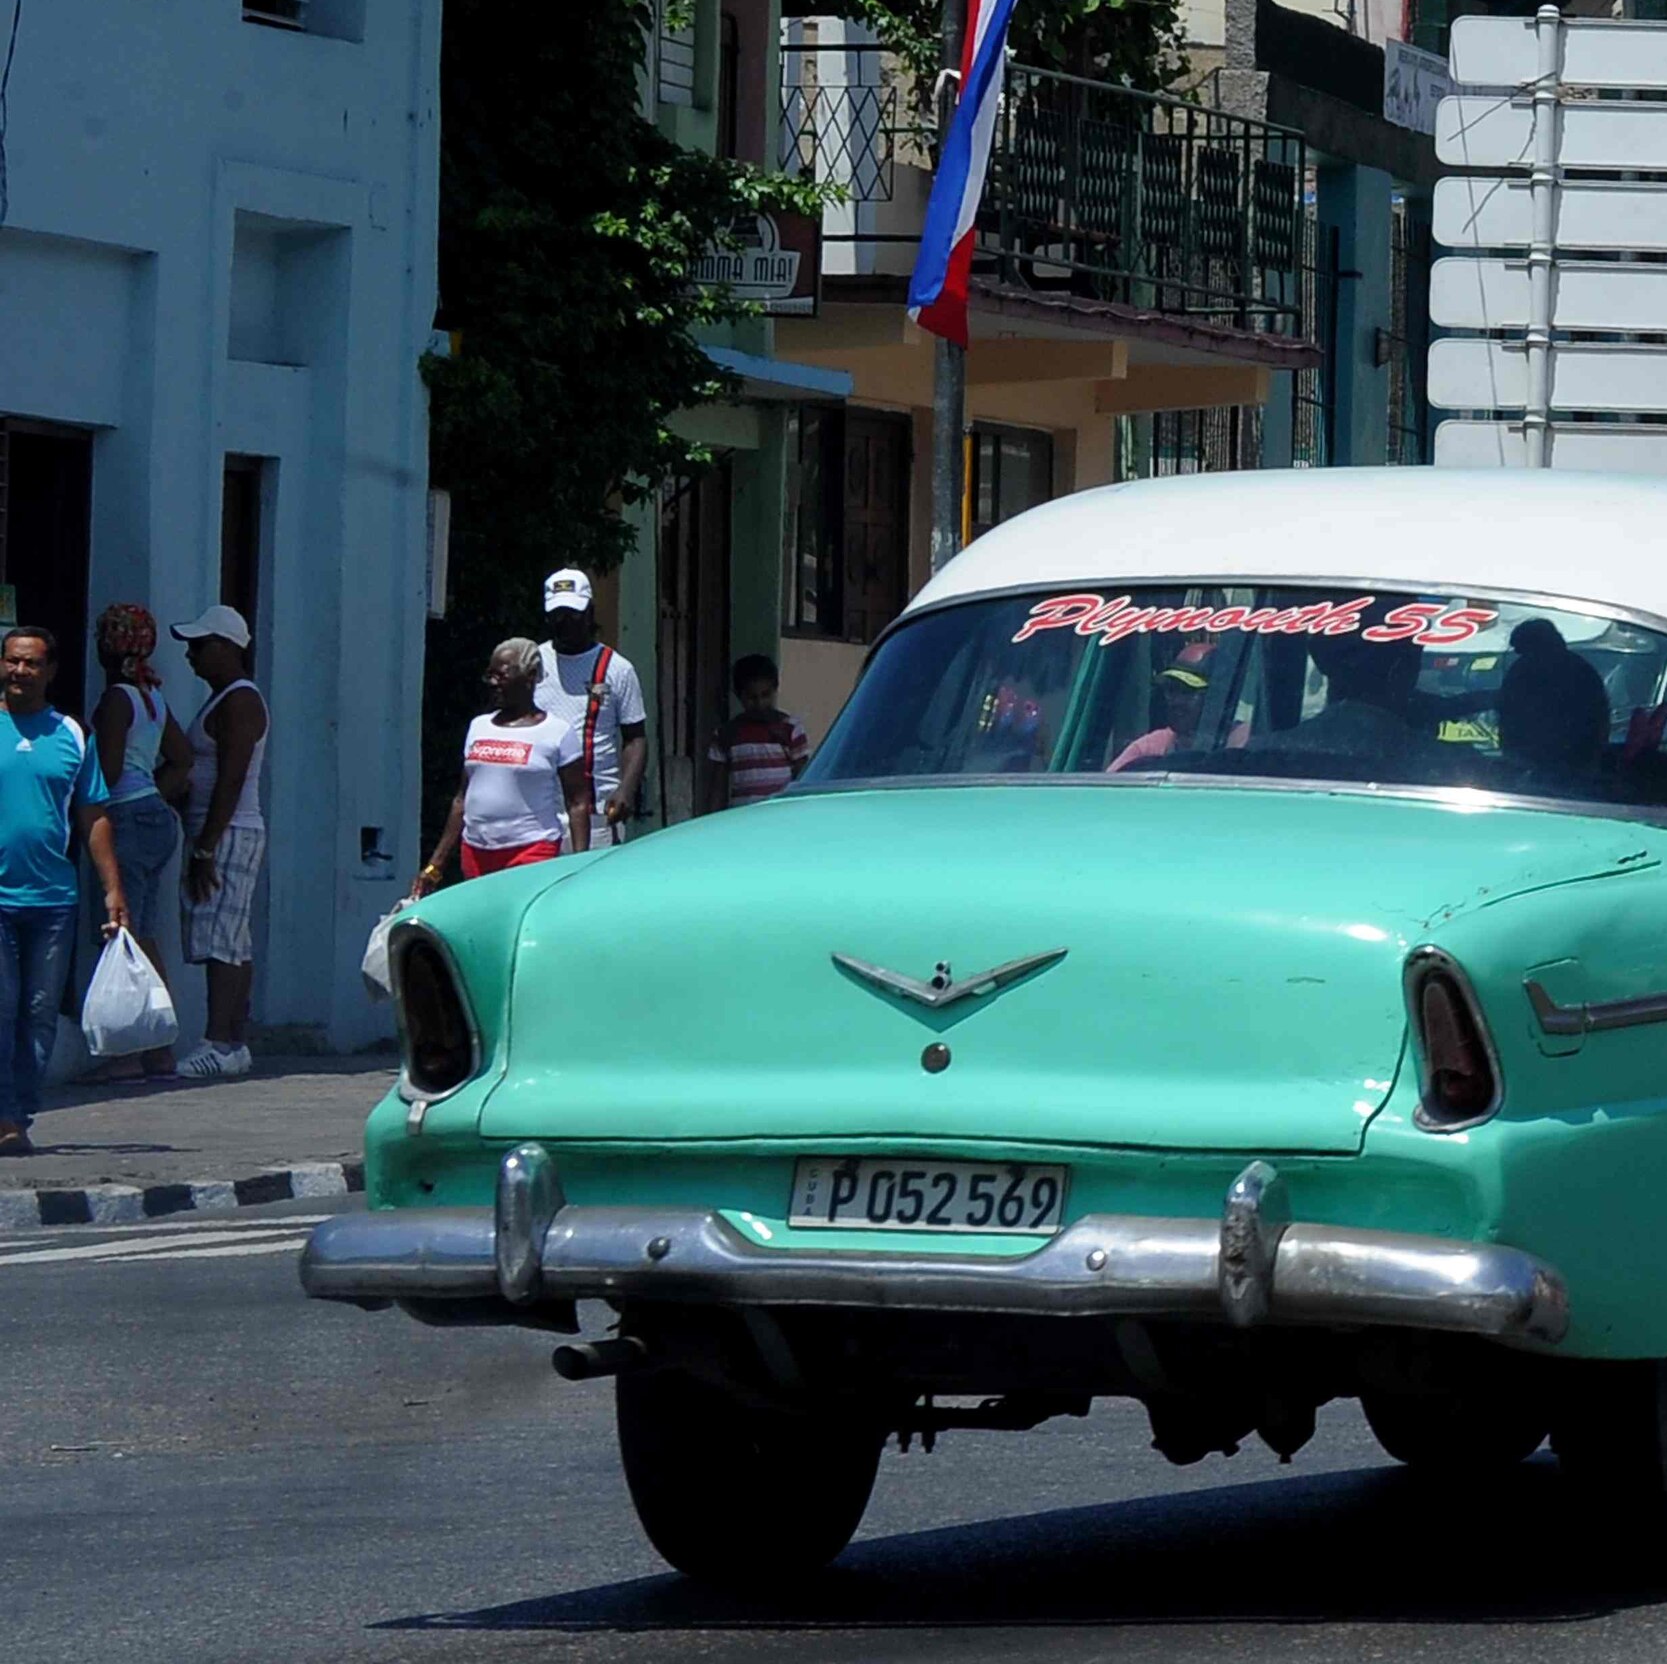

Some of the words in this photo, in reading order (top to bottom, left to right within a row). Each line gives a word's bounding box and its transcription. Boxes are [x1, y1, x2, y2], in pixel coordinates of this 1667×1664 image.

[754, 256, 792, 282] MIA!
[1011, 593, 1375, 646] Plymouth
[1362, 602, 1498, 646] 55
